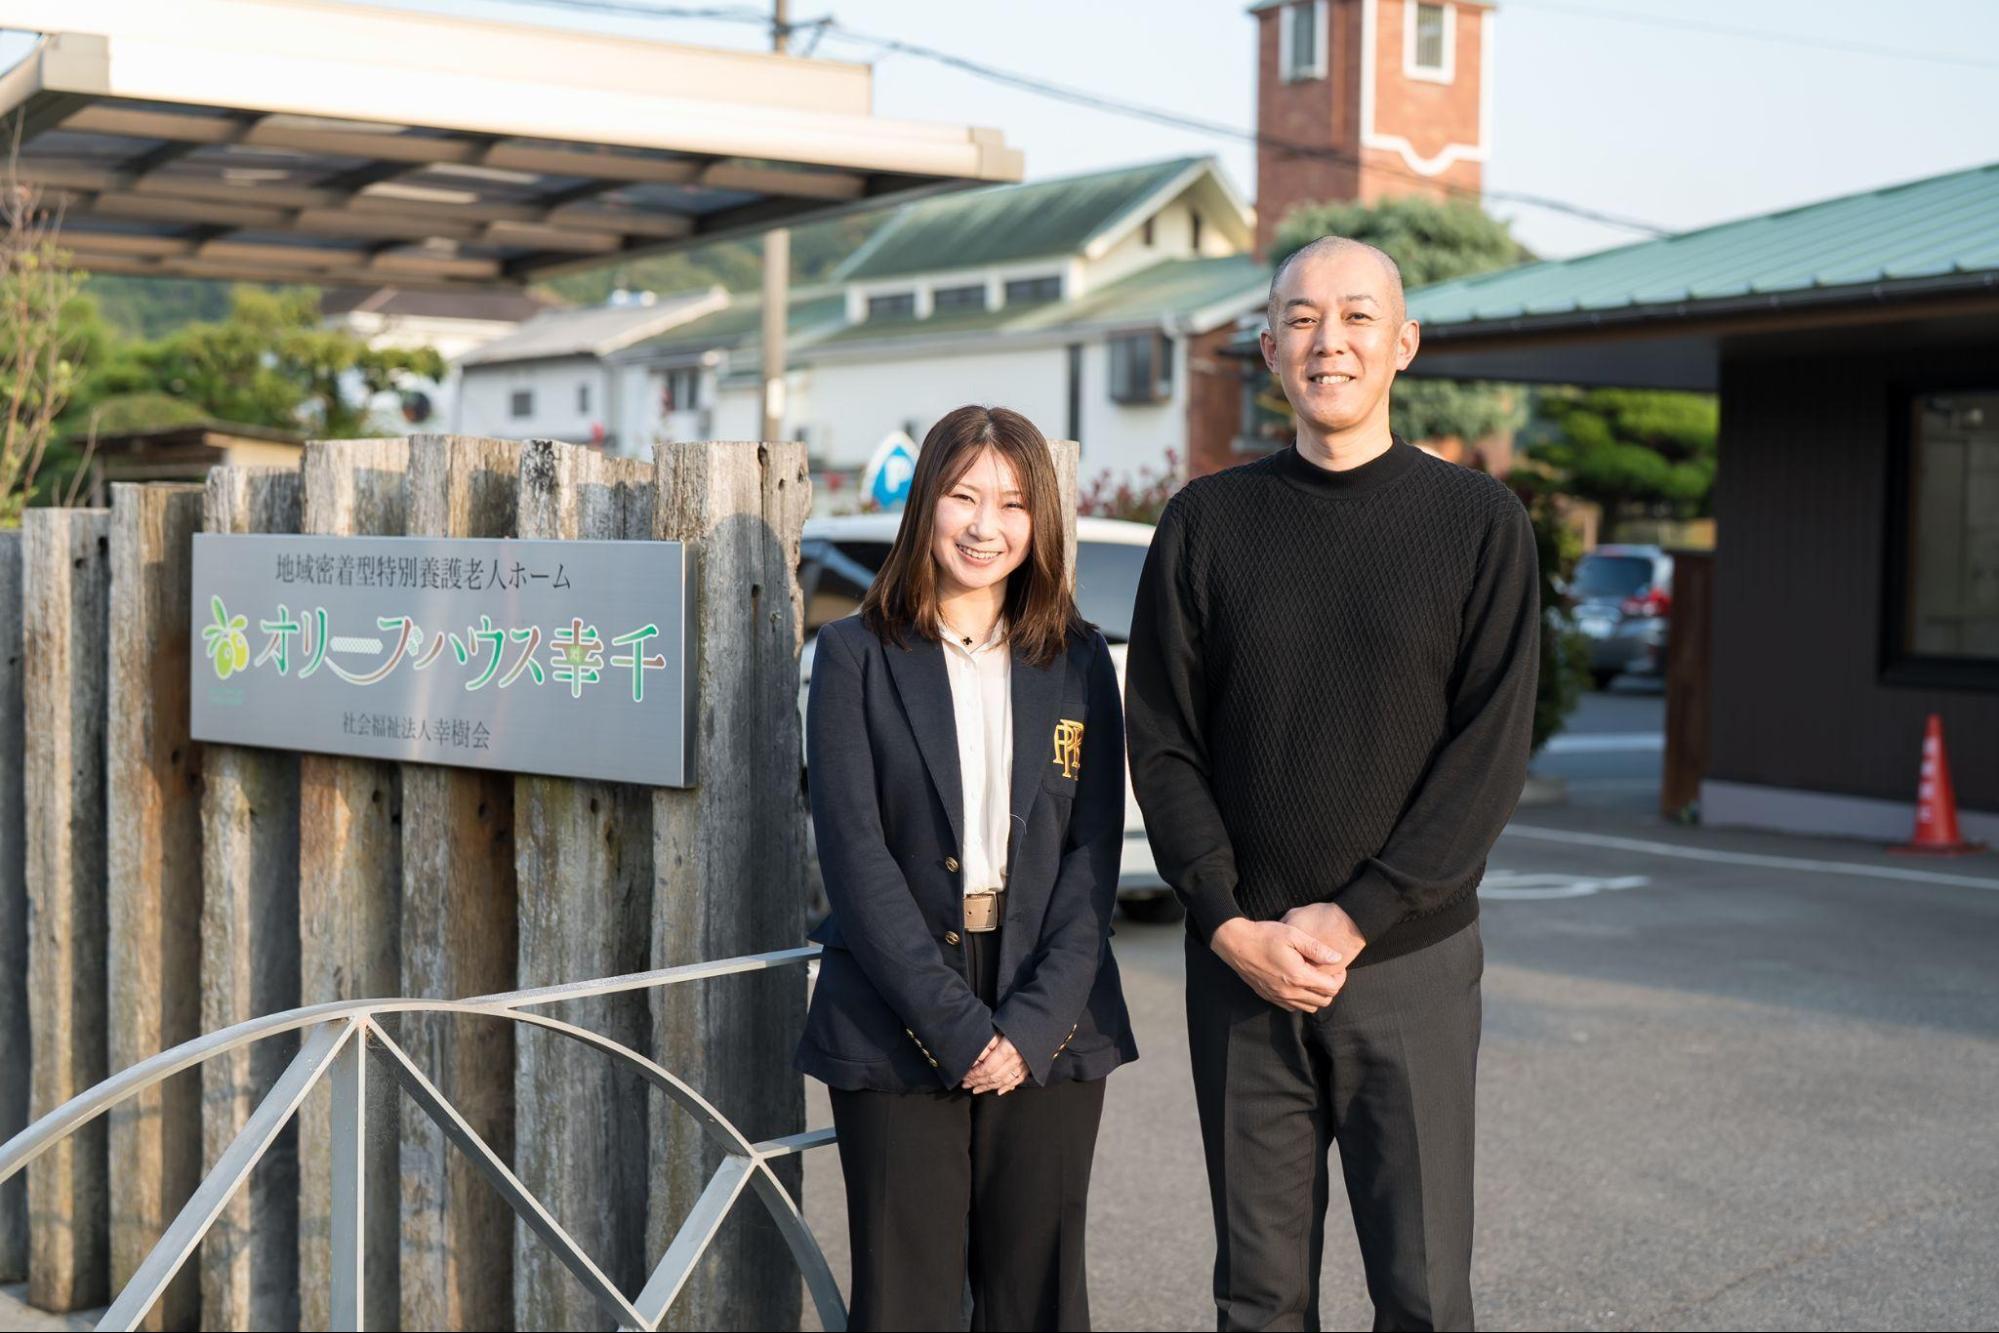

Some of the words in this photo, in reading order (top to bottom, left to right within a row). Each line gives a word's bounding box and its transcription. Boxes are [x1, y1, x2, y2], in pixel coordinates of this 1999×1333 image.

[276, 552, 571, 590] 地域密着型特別養護老人ホーム
[254, 604, 666, 702] オリーブハウス幸千
[343, 711, 491, 750] 社会福祉法人幸樹会
